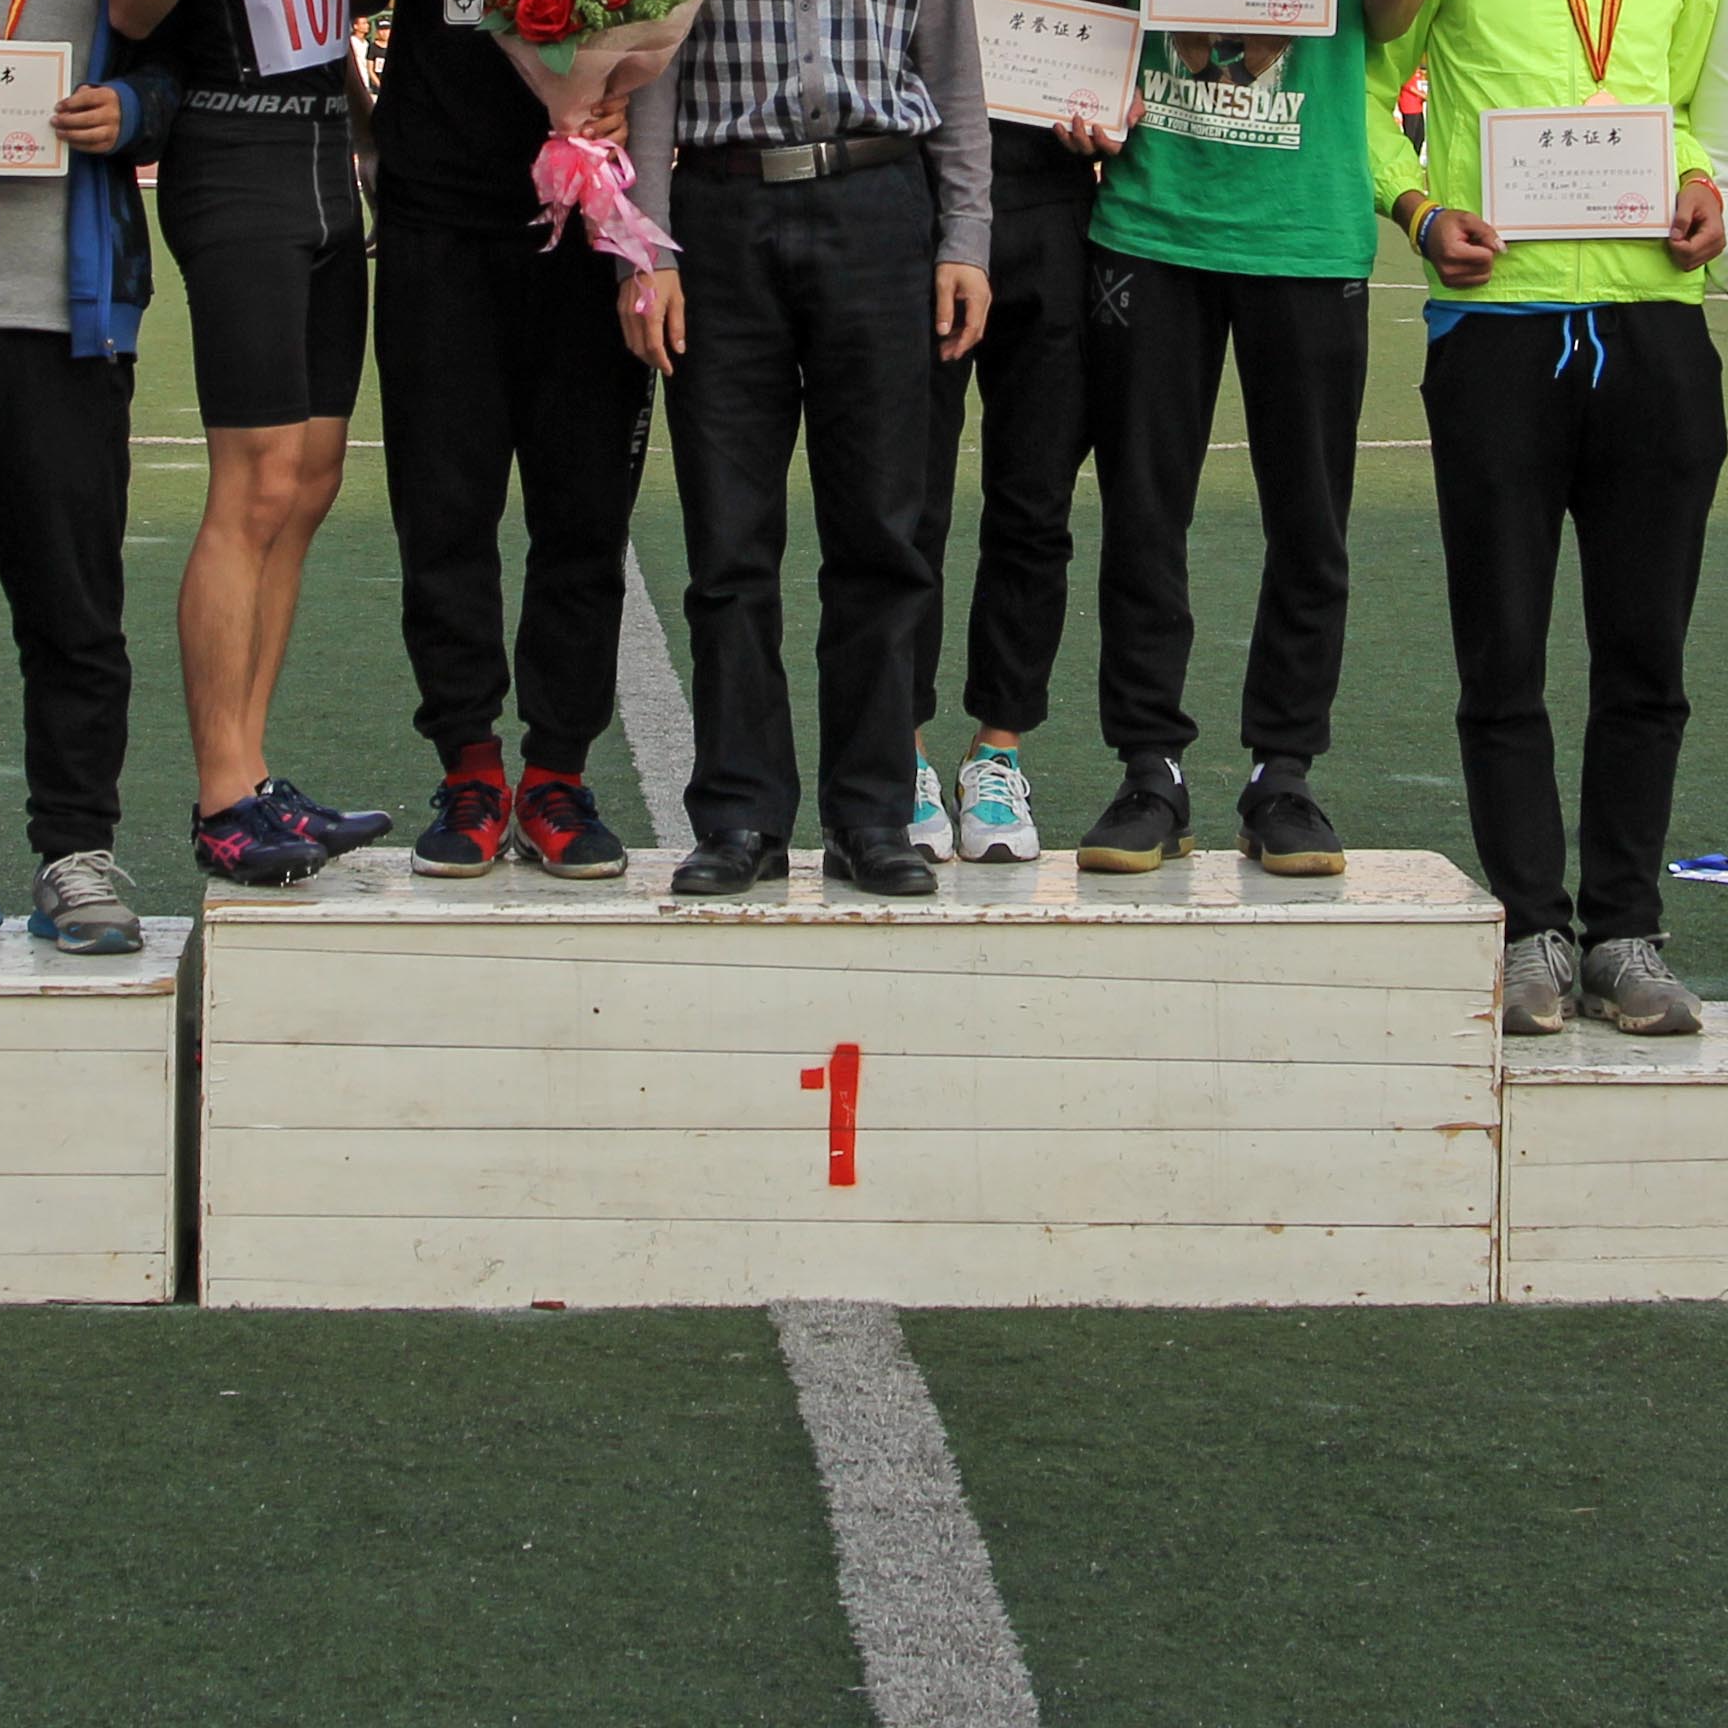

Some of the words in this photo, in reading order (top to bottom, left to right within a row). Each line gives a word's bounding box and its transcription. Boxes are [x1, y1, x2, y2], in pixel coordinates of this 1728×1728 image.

[1008, 11, 1094, 41] 荣誉证书
[190, 91, 317, 114] COMBAT
[1144, 70, 1305, 124] WEDNESDAY
[1167, 118, 1190, 132] YOUR
[1190, 121, 1230, 139] MOMENT
[1539, 128, 1622, 148] 荣誉证书
[801, 1042, 861, 1188] 1
